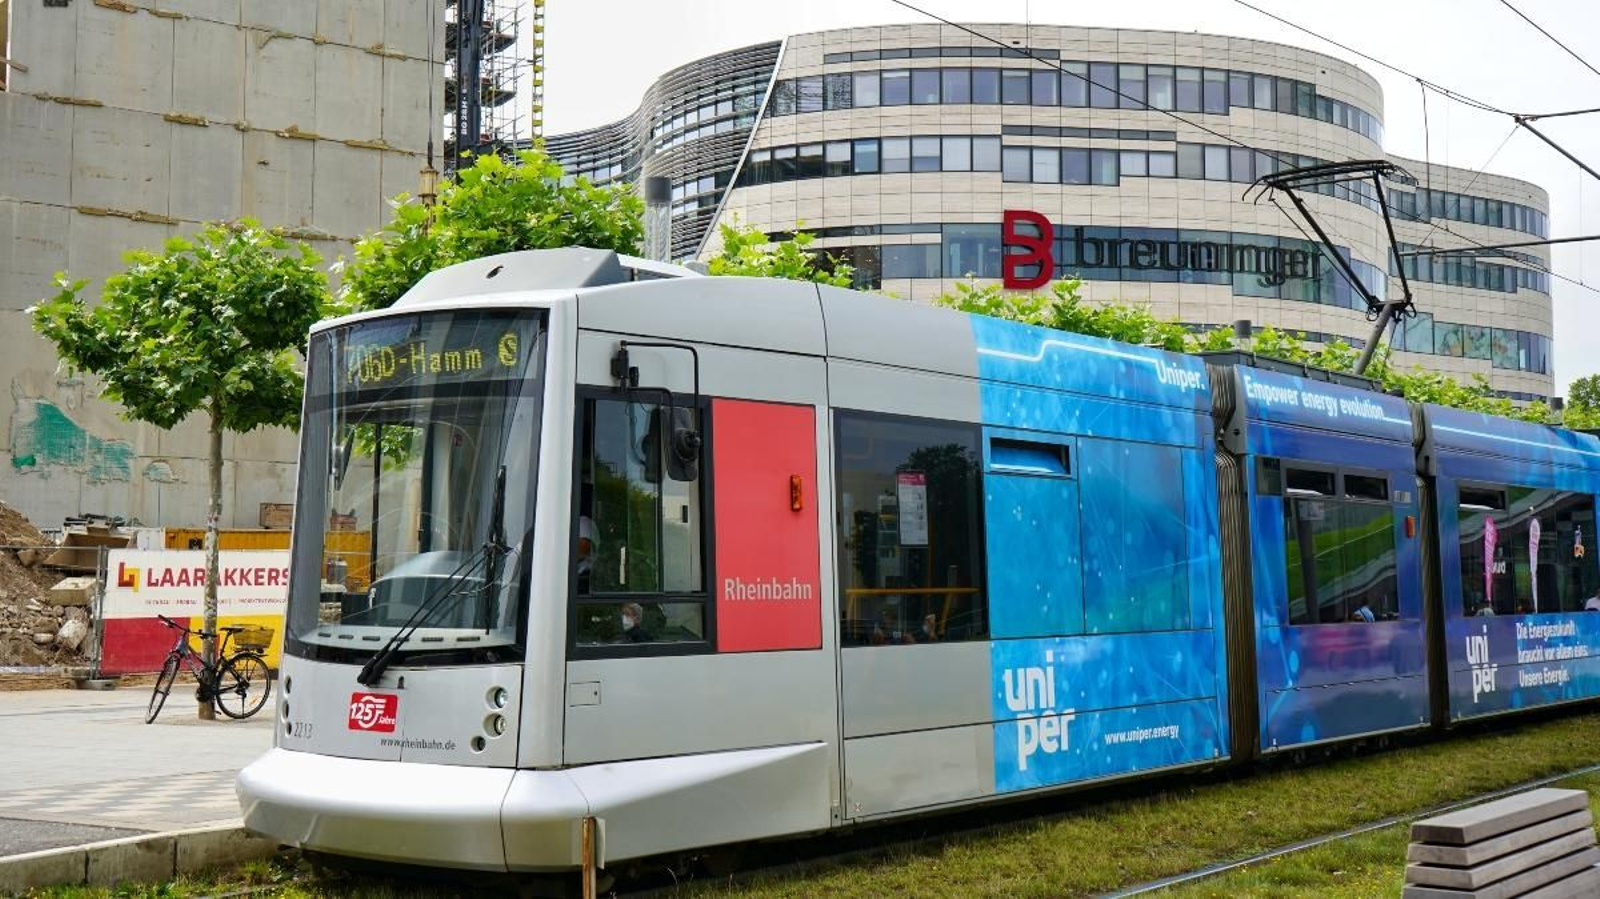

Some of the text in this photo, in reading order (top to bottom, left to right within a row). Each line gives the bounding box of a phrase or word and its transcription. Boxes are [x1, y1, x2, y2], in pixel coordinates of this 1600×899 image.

[1155, 359, 1206, 390] Uniper.
[1244, 375, 1299, 406] Empower
[1301, 391, 1338, 416] energy
[147, 567, 289, 588] LAARKKERS
[724, 577, 812, 601] Rheinbahn
[1516, 622, 1528, 640] Die
[1465, 624, 1489, 665] uni
[1003, 650, 1056, 712] uni
[1471, 663, 1498, 704] per
[1519, 669, 1543, 688] Unsere
[351, 702, 375, 722] 125
[380, 737, 457, 751] www.rheinbahn.de
[1016, 708, 1076, 771] per
[1104, 724, 1180, 745] www.uniper.energy
